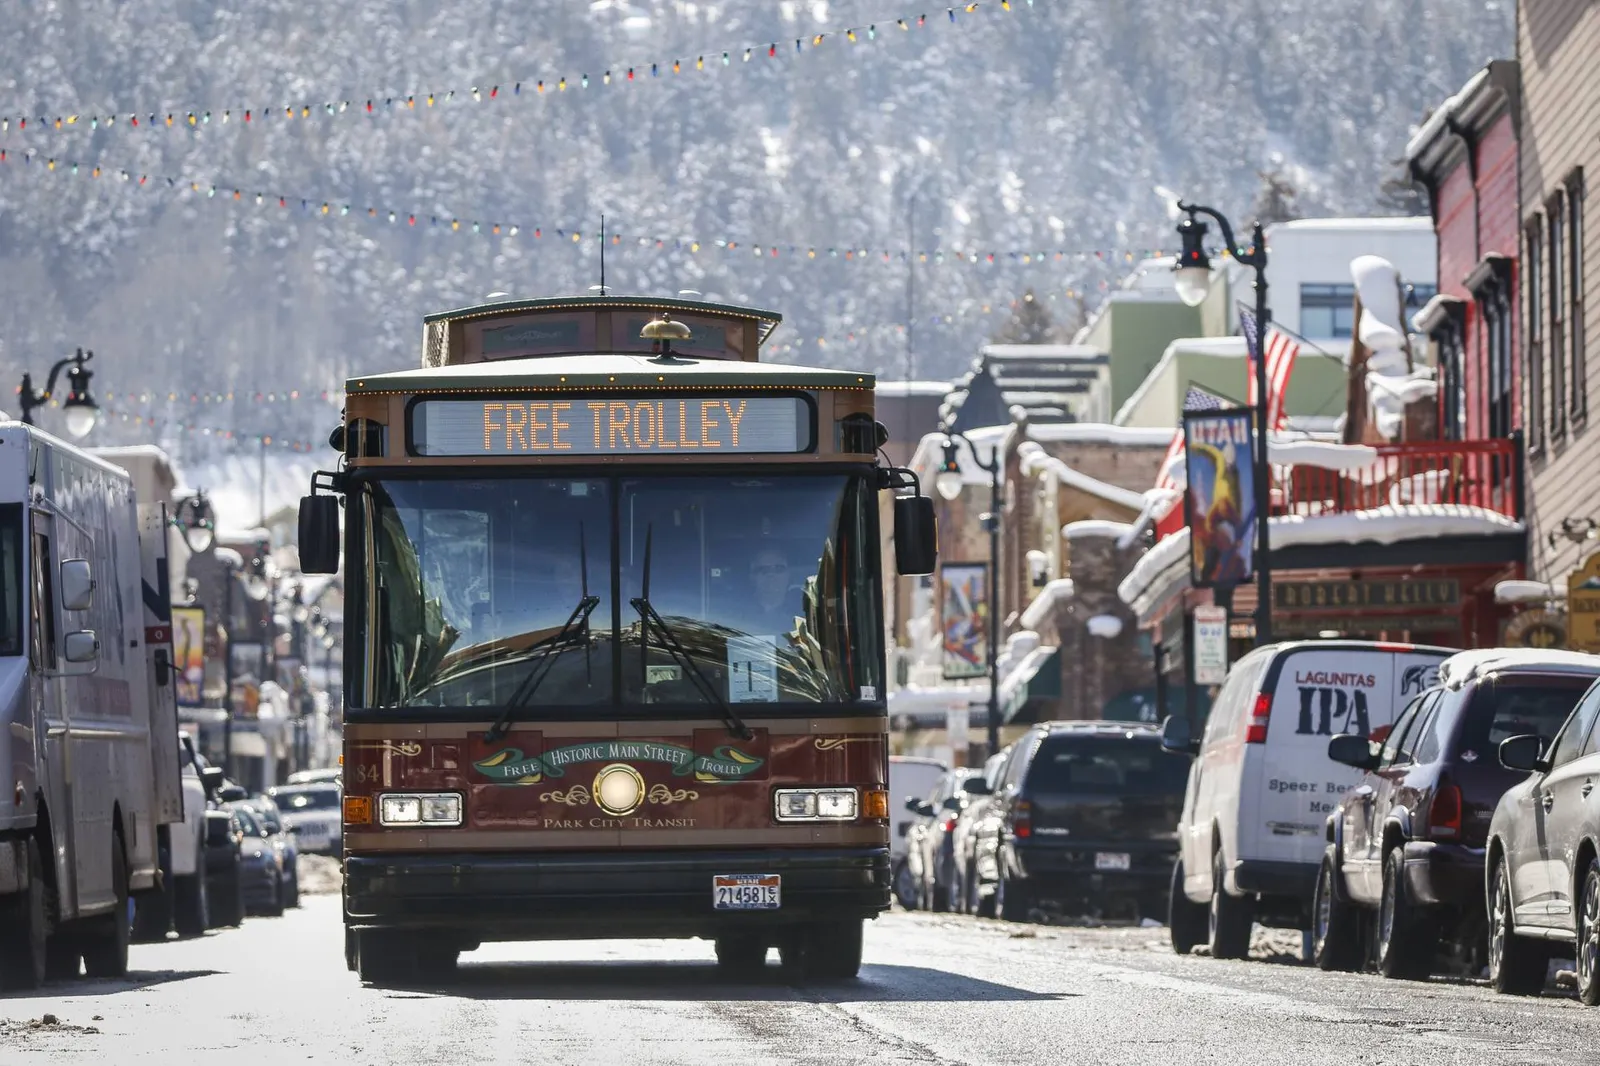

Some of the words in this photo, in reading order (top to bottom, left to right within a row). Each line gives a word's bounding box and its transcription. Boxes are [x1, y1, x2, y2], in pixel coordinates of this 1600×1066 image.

[483, 400, 571, 450] FREE
[587, 400, 747, 450] TROLLEY
[1190, 417, 1248, 445] UTAH
[1295, 671, 1376, 688] LAGUNITAS
[1295, 686, 1371, 736] IPA
[503, 762, 540, 777] FREE
[551, 746, 604, 766] HISTORIC
[609, 743, 640, 759] MAIN
[644, 744, 687, 765] STREET
[700, 757, 742, 775] TROLLEY
[1268, 778, 1318, 794] Speer
[1309, 801, 1336, 813] Me
[544, 818, 584, 829] PARK
[589, 817, 625, 829] CITY
[632, 817, 697, 828] TRANSIT
[719, 887, 767, 904] 214581
